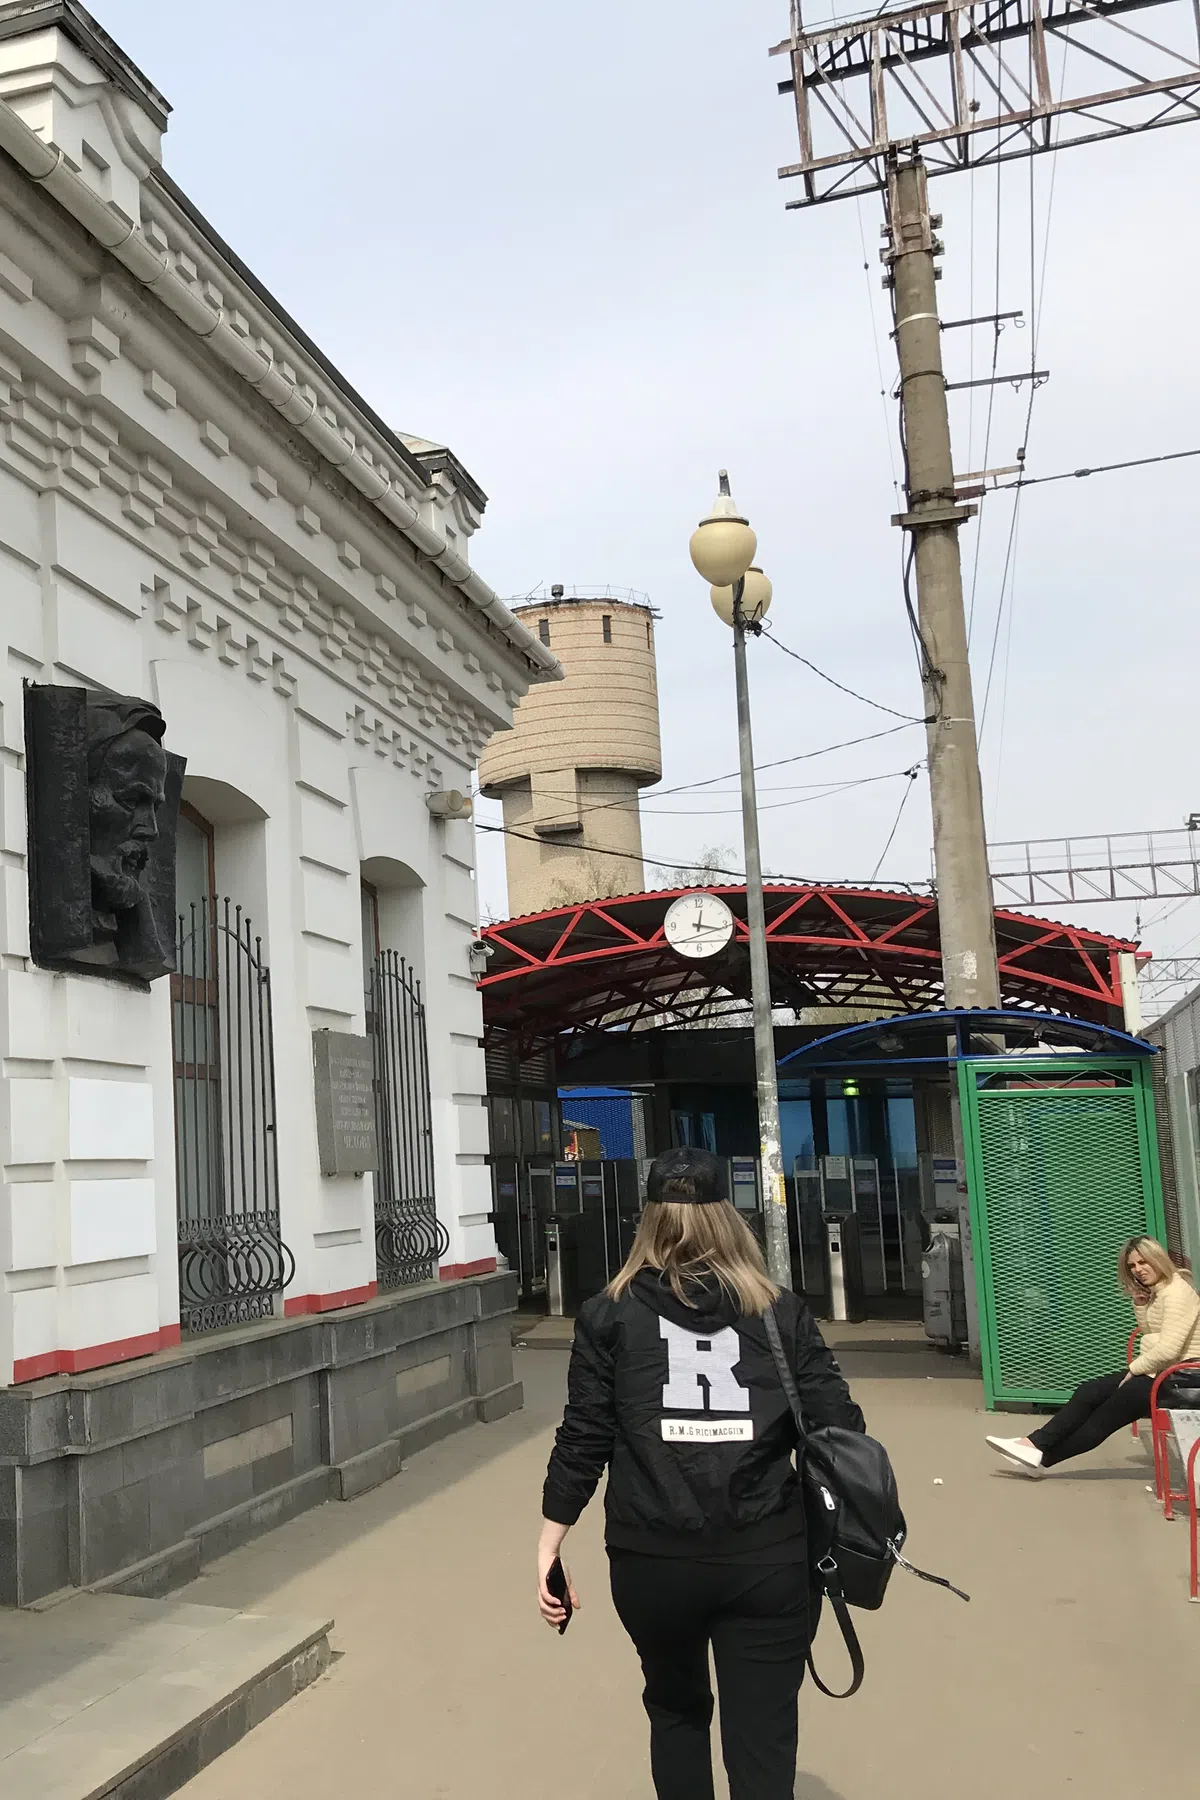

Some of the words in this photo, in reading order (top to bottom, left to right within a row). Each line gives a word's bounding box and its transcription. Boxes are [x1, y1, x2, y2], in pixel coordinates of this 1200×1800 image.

[694, 898, 704, 909] 12
[670, 921, 677, 931] 9
[722, 919, 728, 929] 3
[696, 943, 703, 953] 6
[658, 1315, 750, 1412] R
